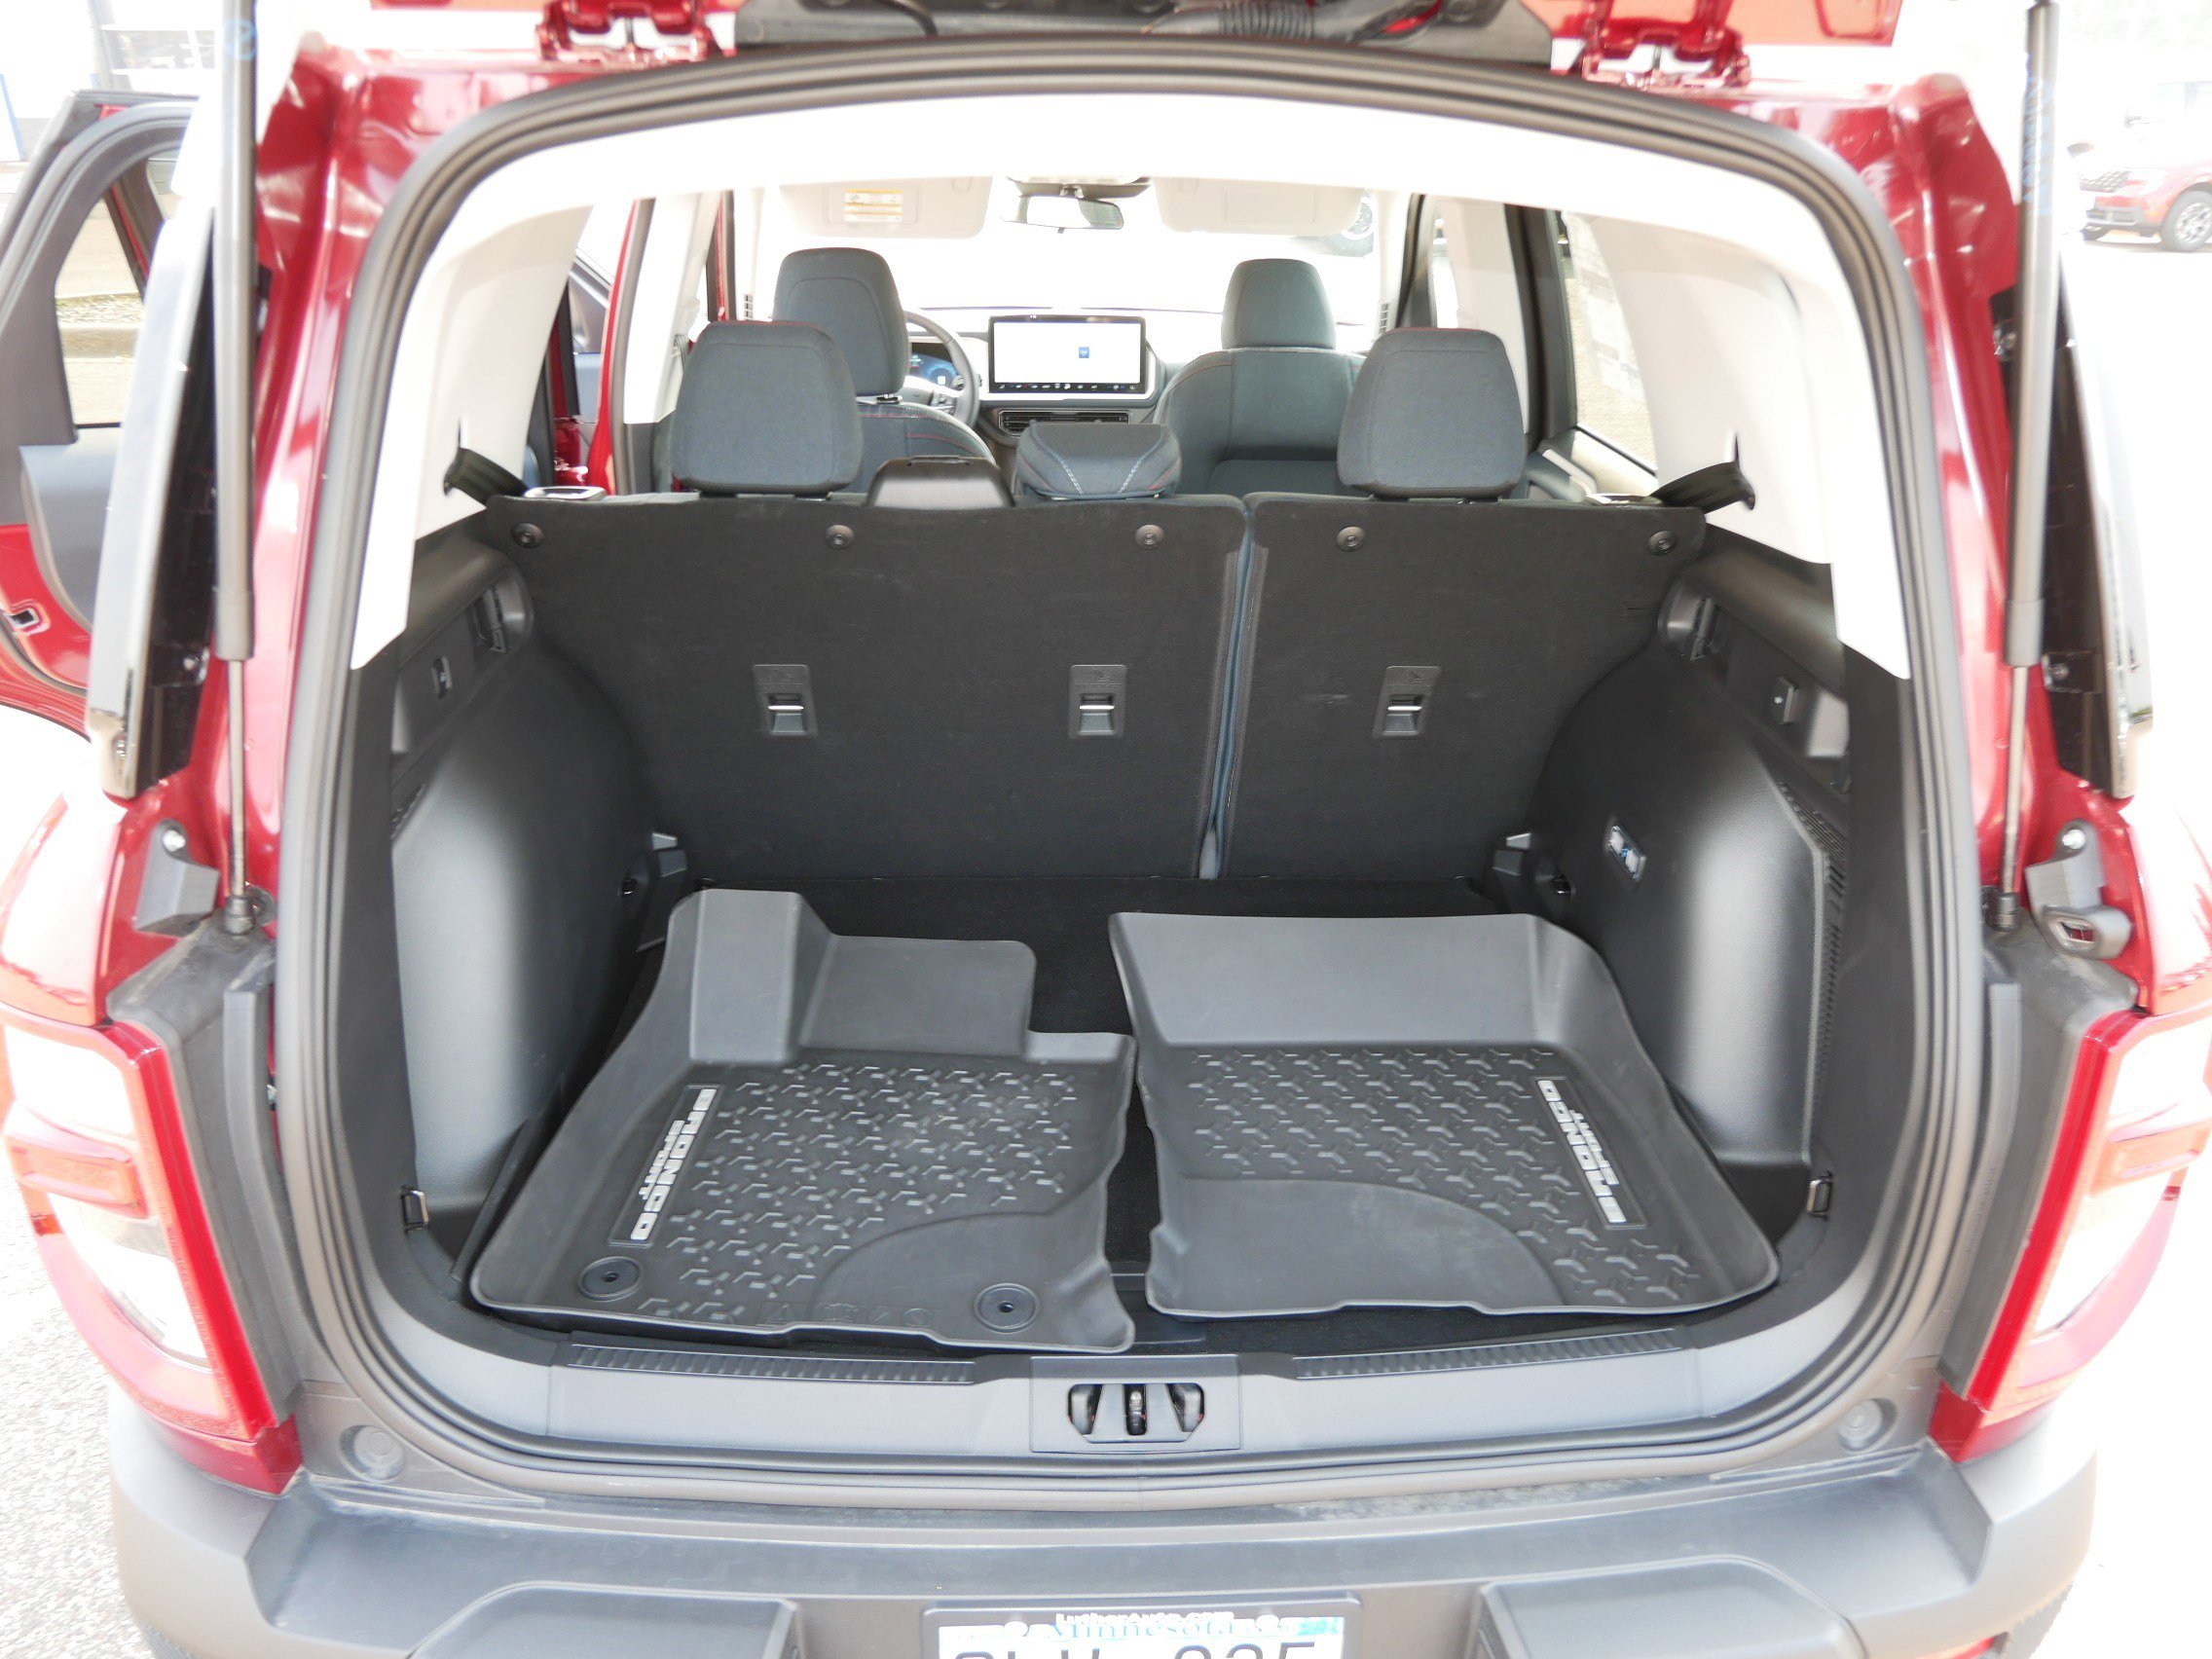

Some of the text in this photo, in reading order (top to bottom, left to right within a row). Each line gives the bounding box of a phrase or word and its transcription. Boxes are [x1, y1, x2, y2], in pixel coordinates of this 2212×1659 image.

[630, 1088, 718, 1240] BRONCO
[638, 1120, 685, 1200] SPORT
[1537, 1080, 1627, 1224] BRONCO
[1568, 1109, 1620, 1186] SPORT
